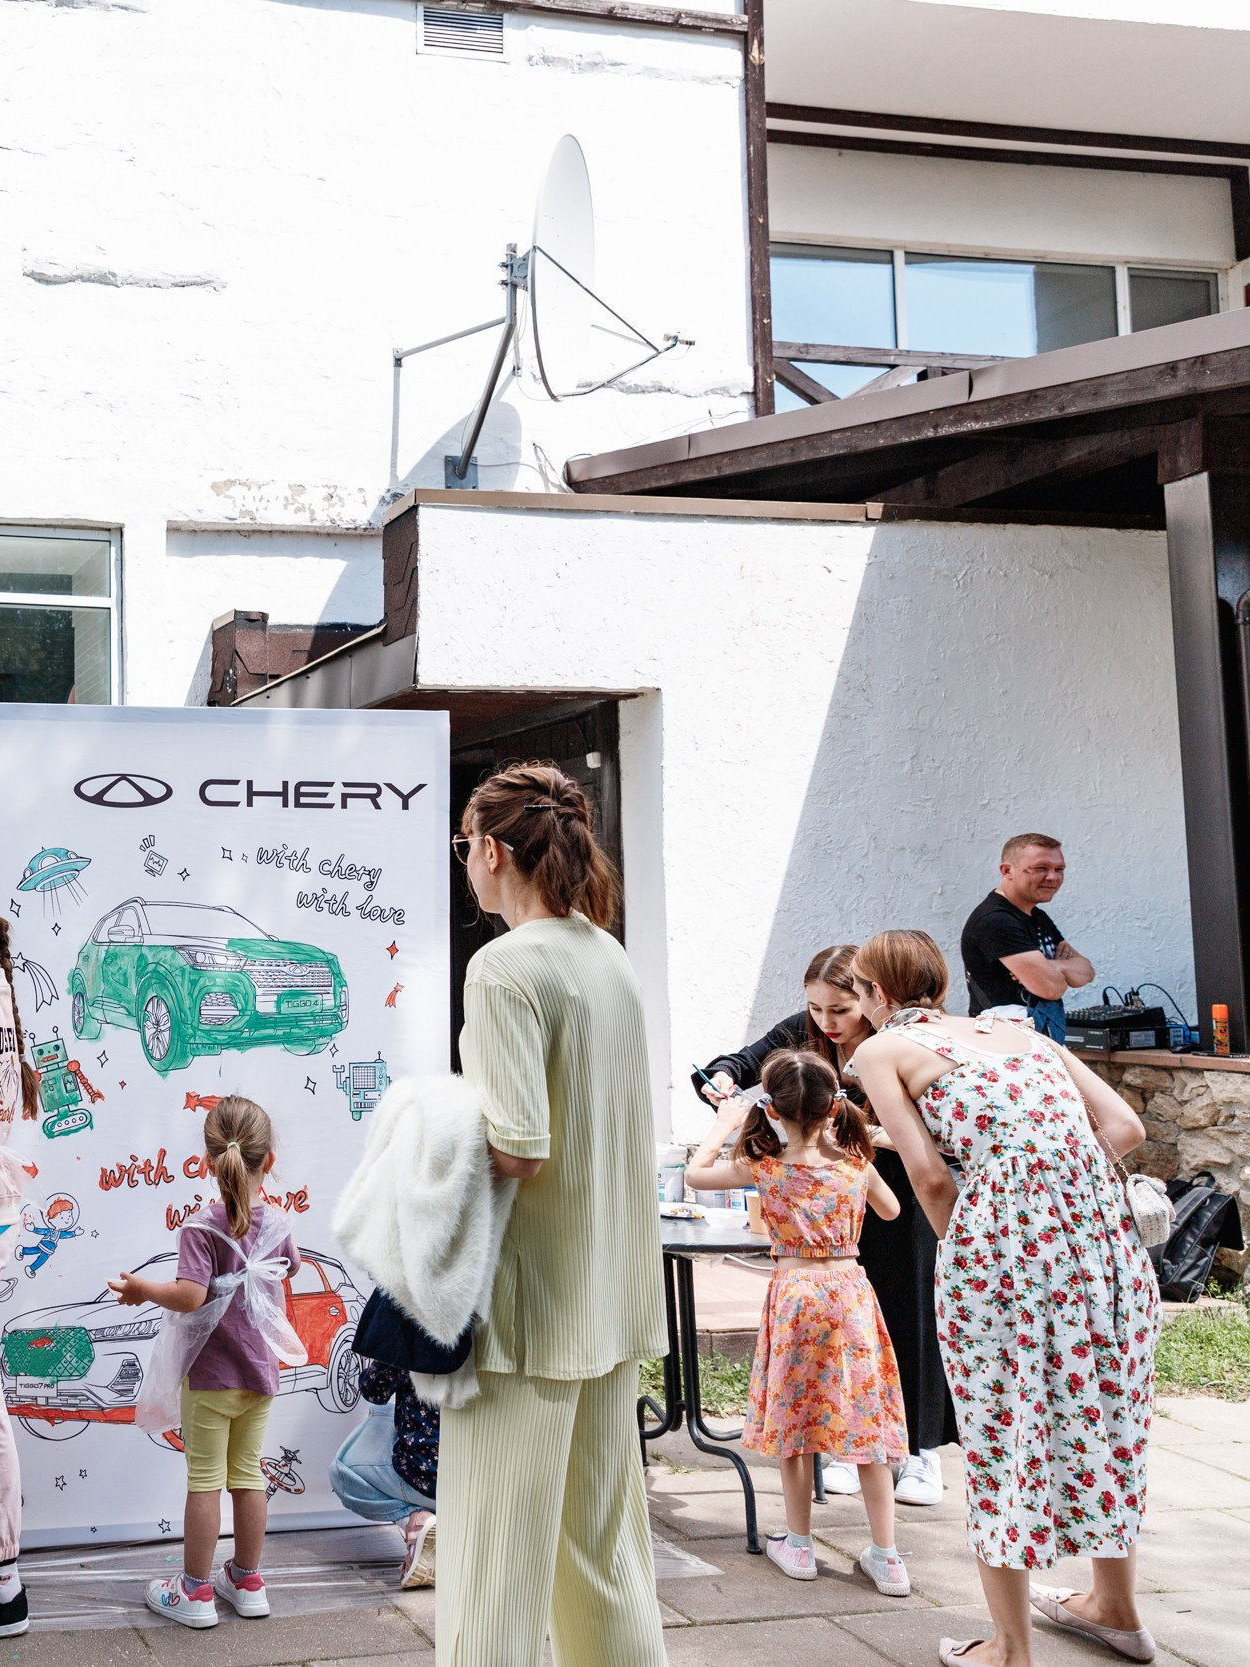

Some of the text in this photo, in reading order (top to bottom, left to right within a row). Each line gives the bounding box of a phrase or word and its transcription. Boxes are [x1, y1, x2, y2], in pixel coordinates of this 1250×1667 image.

[199, 778, 428, 811] CHERY
[256, 843, 382, 891] with chery
[296, 887, 405, 925] with love
[285, 999, 312, 1008] TIGGO
[99, 1147, 174, 1191] with
